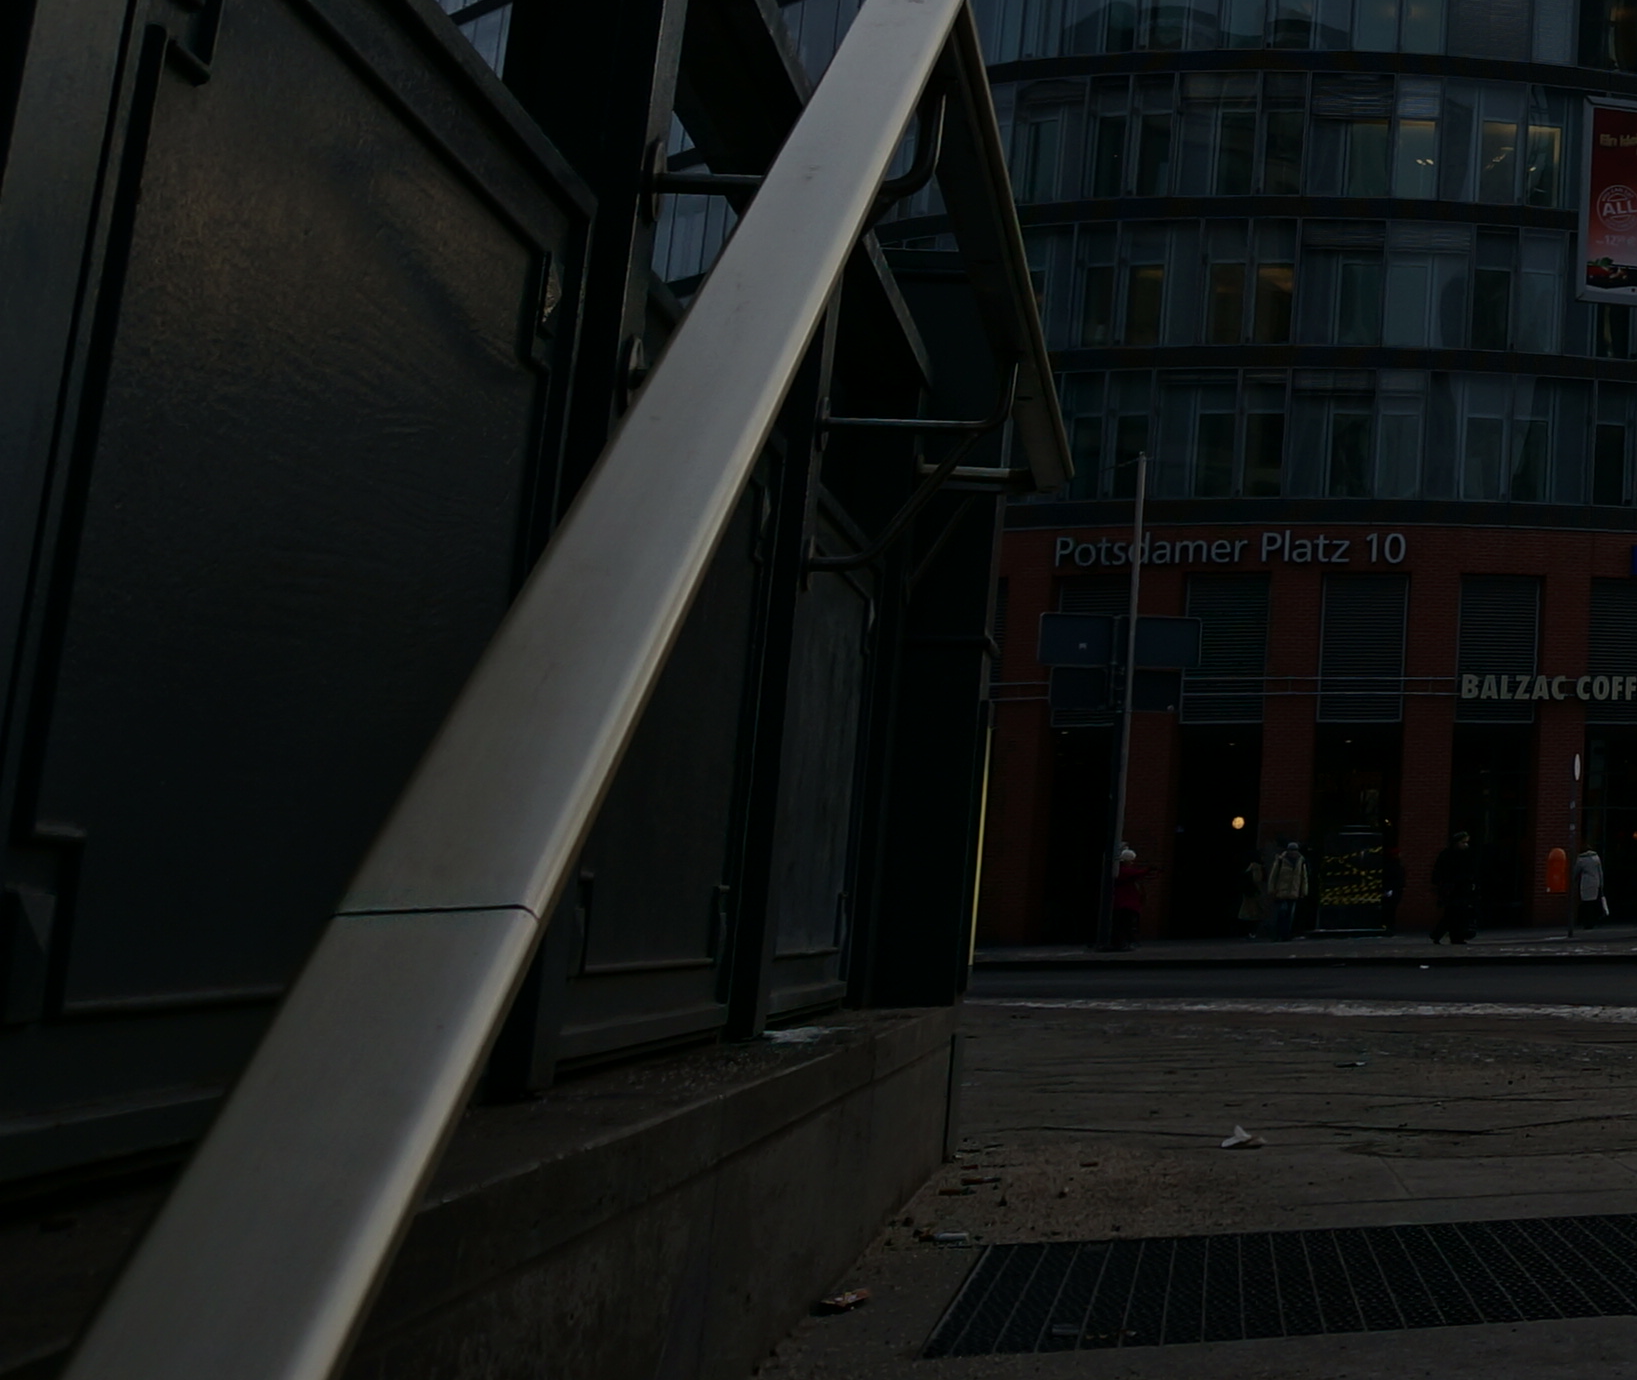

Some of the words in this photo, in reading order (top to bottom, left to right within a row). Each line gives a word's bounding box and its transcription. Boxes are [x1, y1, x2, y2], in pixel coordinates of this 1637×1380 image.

[1054, 531, 1248, 568] Potsdamer
[1260, 529, 1351, 565] Platz
[1365, 531, 1408, 565] 10
[1460, 673, 1567, 701] BALZAC
